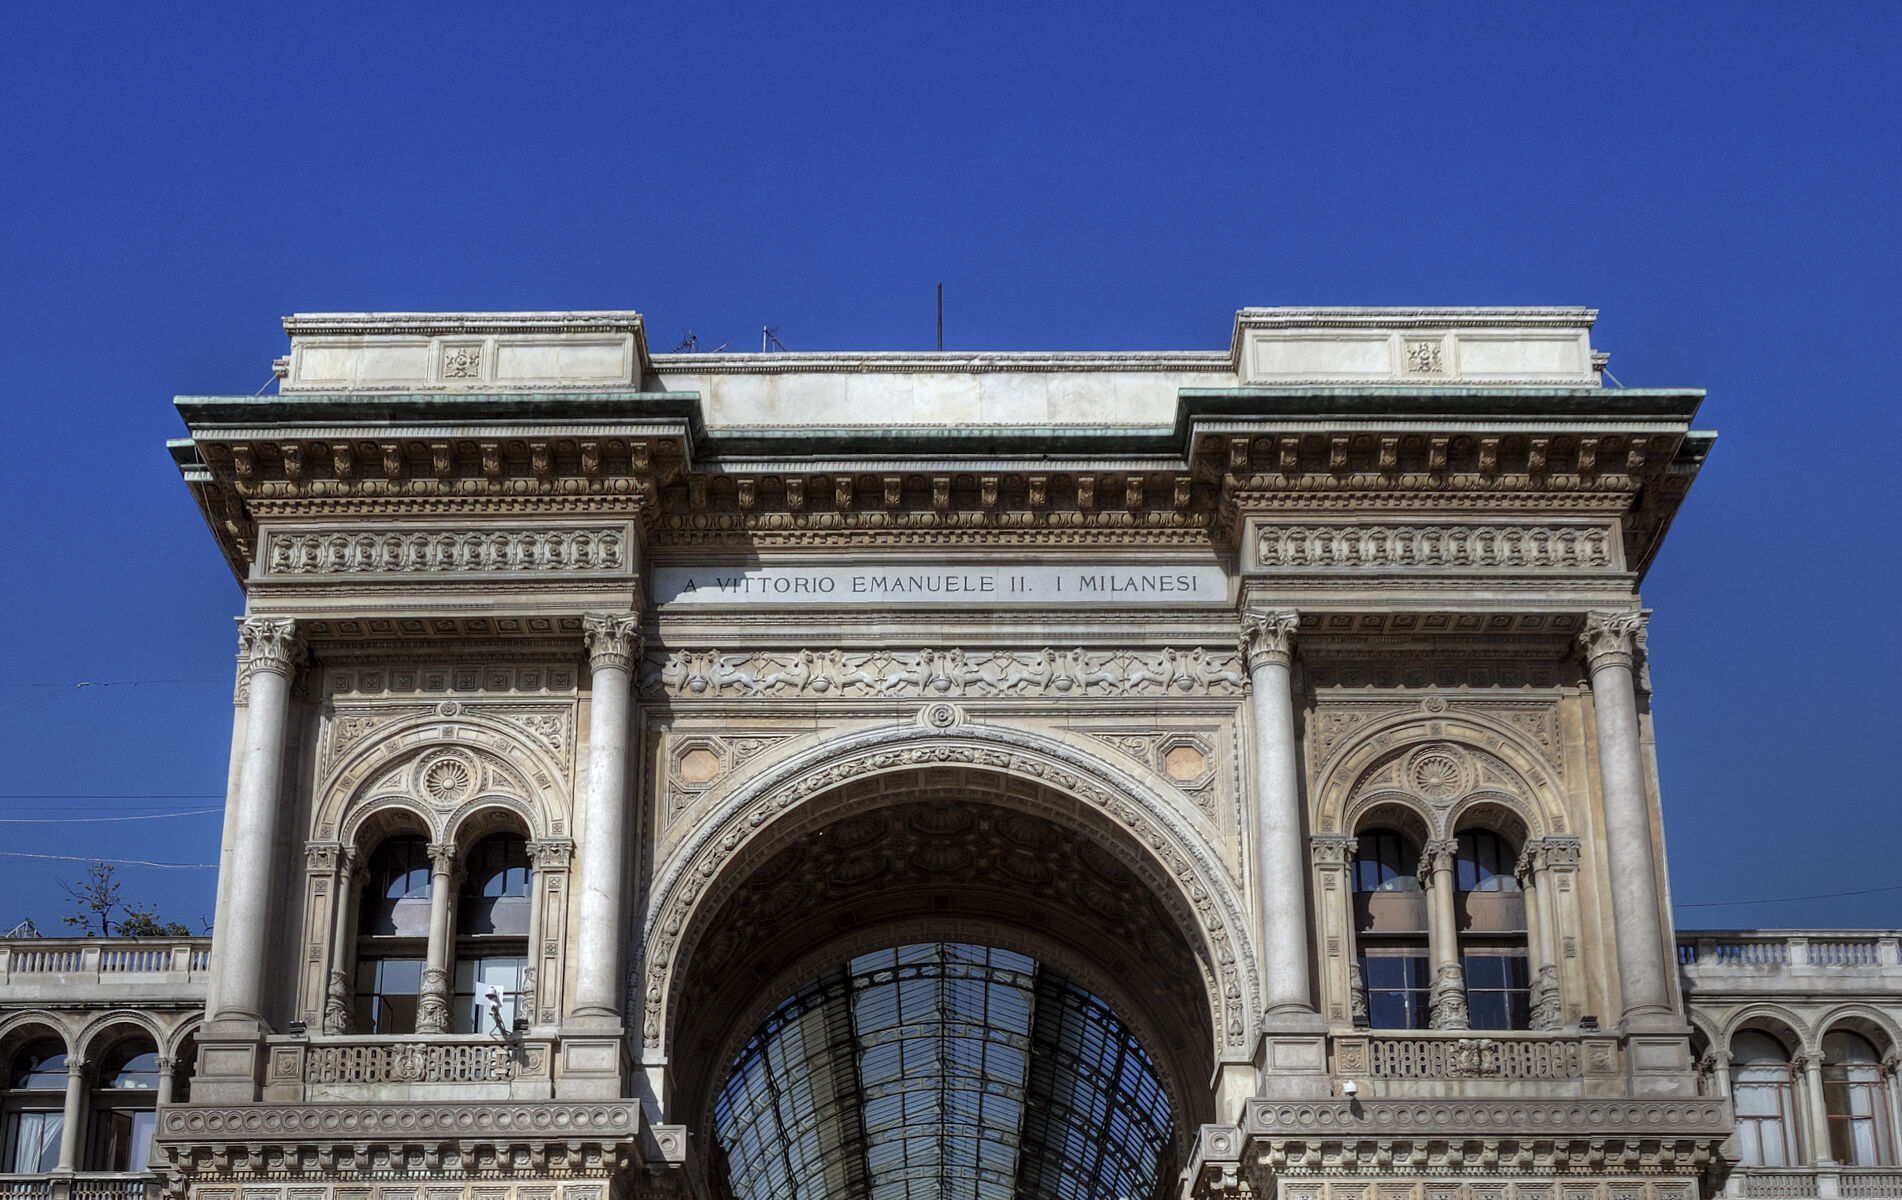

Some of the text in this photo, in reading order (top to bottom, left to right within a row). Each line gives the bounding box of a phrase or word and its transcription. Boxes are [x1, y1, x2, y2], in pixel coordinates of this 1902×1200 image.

[683, 578, 698, 593] A
[716, 577, 835, 594] VITTORIO
[852, 576, 996, 593] EMANUELE
[1079, 575, 1198, 592] MILANESI
